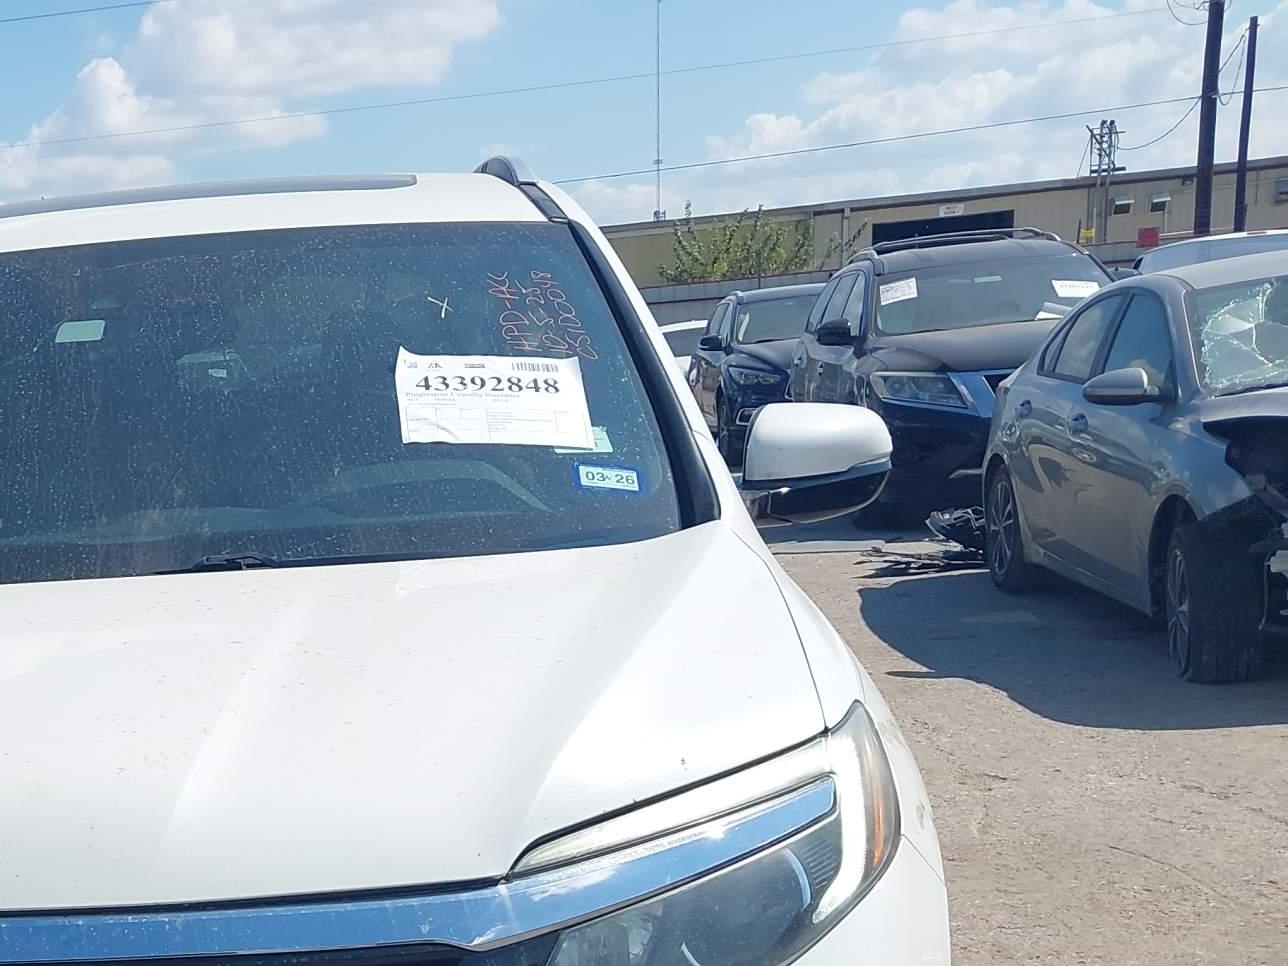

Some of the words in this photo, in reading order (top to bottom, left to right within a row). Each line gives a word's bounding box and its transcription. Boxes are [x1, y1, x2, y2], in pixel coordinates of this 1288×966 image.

[415, 375, 561, 394] 43392848
[585, 470, 606, 482] 03
[614, 473, 636, 485] 26
